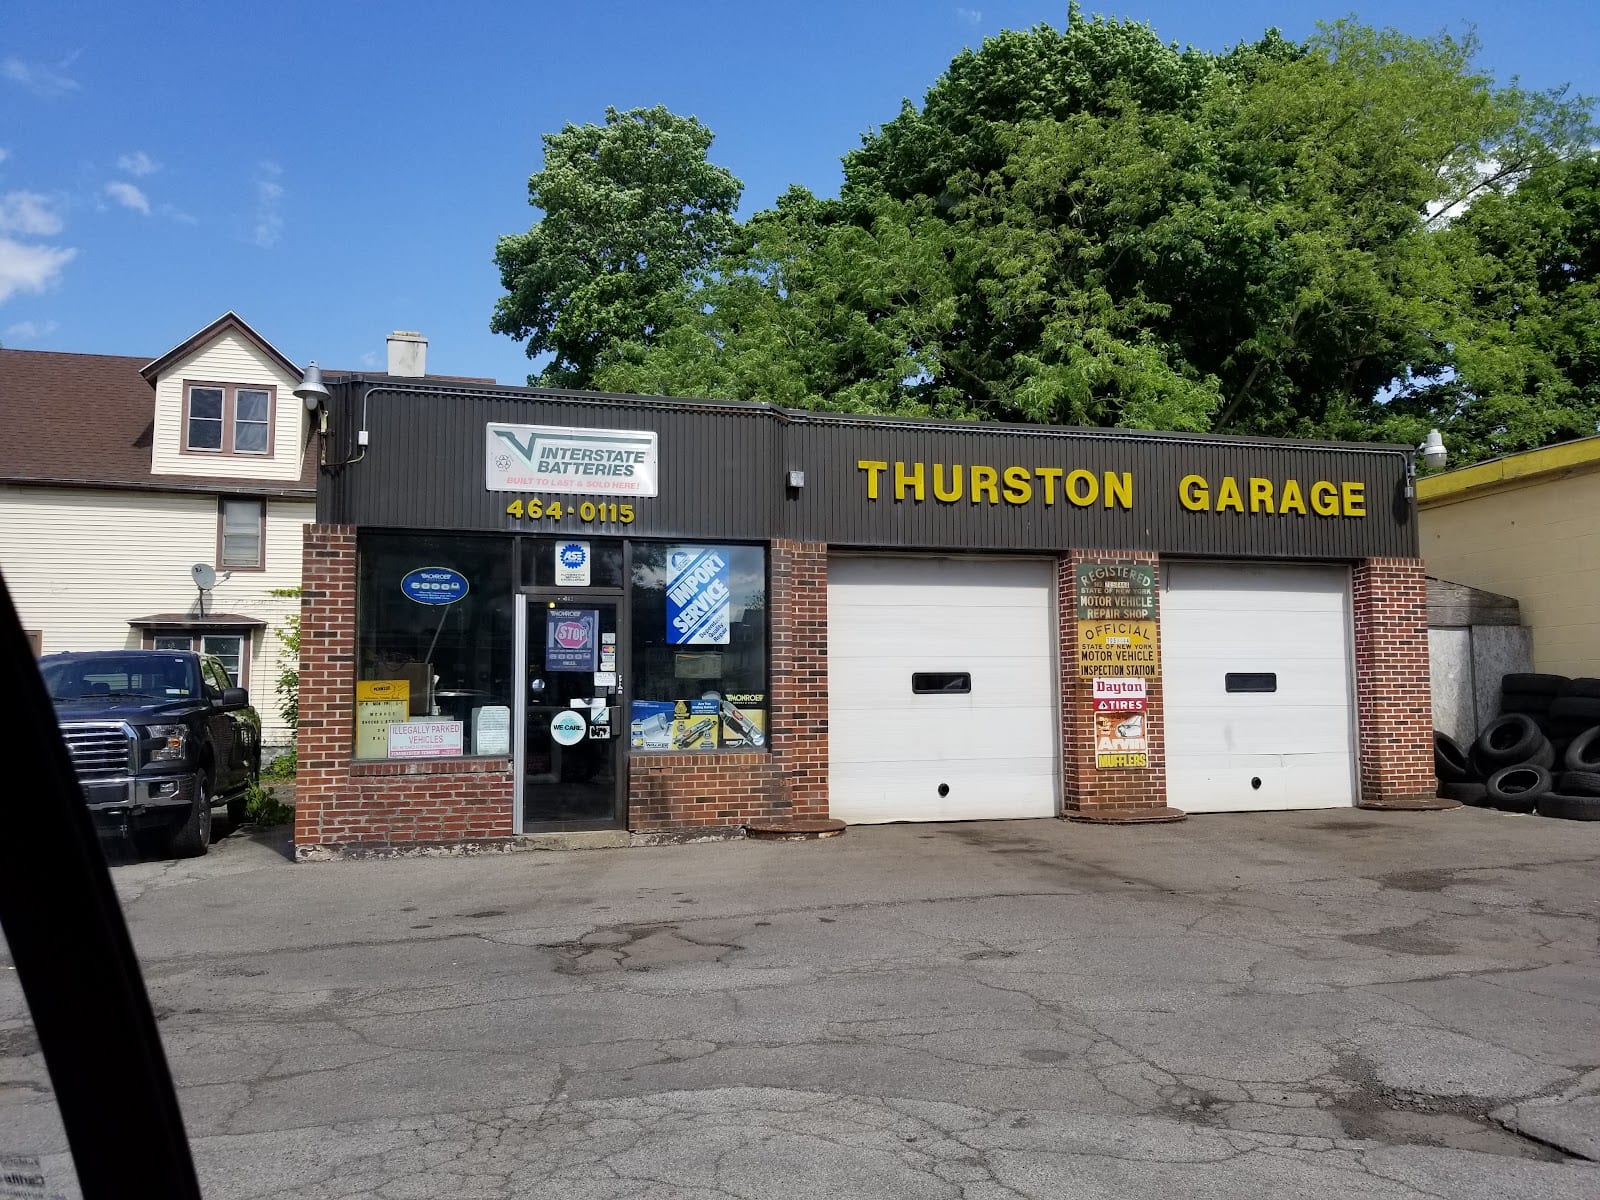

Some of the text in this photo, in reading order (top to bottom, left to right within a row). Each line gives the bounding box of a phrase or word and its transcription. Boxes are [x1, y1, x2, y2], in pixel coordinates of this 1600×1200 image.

[541, 446, 646, 464] INTERSTATE
[537, 461, 635, 477] BATTERIES
[506, 477, 534, 485] BUILT
[536, 478, 549, 486] TO
[551, 479, 576, 487] LAST
[586, 480, 611, 488] SOLD
[612, 482, 640, 490] HERE!
[857, 459, 1367, 518] THURSTON GARAGE
[563, 551, 583, 563] ASE
[669, 554, 725, 608] IMPORT
[1080, 566, 1151, 587] REGISTERED
[673, 578, 729, 634] SERVICE
[1080, 595, 1153, 607] MOTOR VEHICLE
[1087, 608, 1148, 619] REPAIR SHOP
[558, 625, 587, 641] STOP
[1085, 623, 1150, 640] OFFICIAL
[1081, 650, 1154, 661] MOTOR VEHICLE
[1080, 664, 1155, 676] INSPECTION STATION
[1096, 681, 1143, 694] Dayton
[725, 694, 765, 702] MONROE
[1108, 701, 1143, 710] TIRES
[392, 725, 431, 735] ILLEGALLY
[431, 724, 460, 734] PARKED
[408, 735, 444, 745] VEHICLES
[1097, 736, 1146, 751] Arvin
[1098, 753, 1147, 768] MUFFLERS
